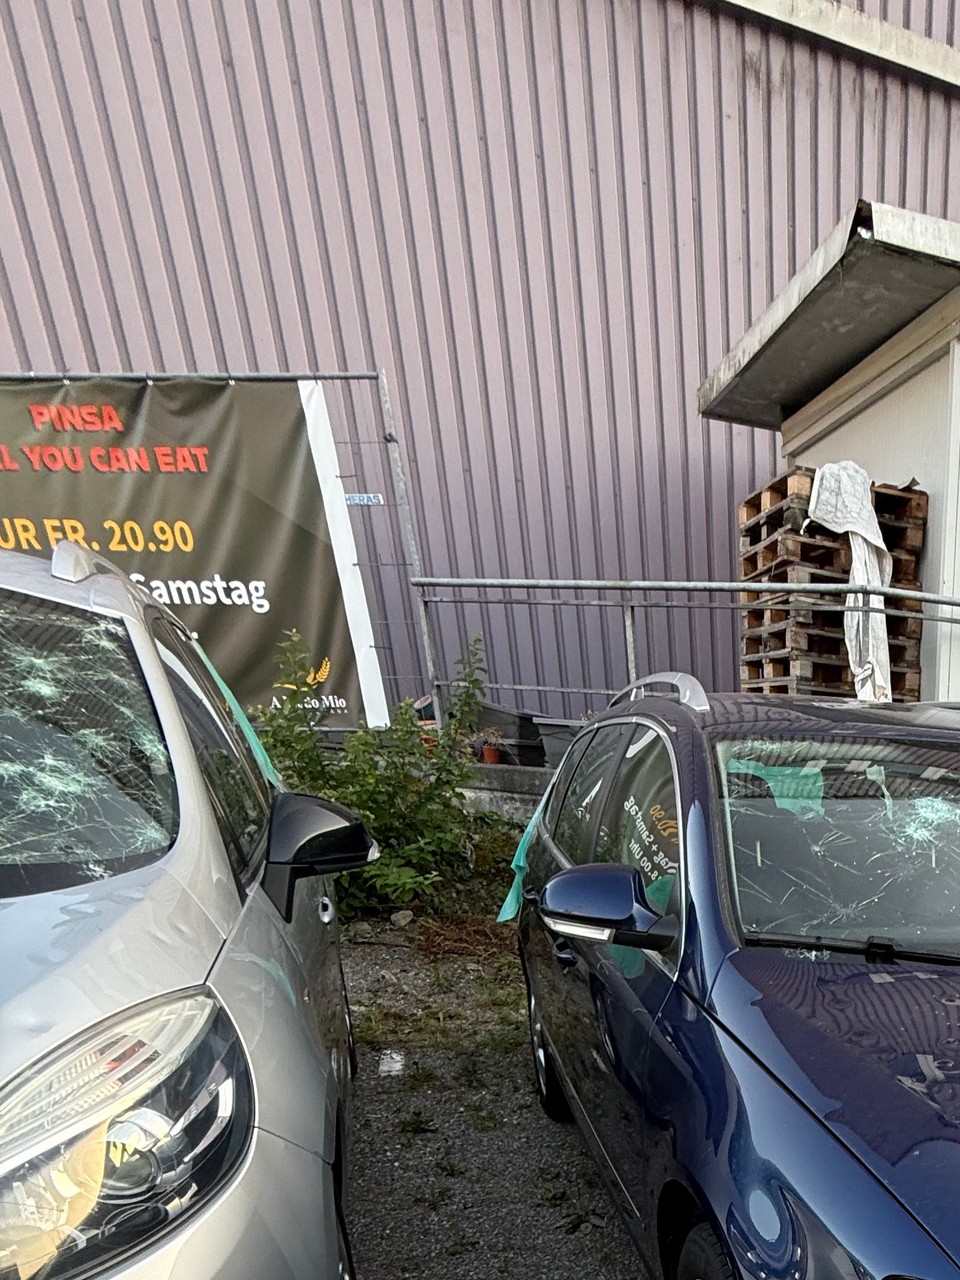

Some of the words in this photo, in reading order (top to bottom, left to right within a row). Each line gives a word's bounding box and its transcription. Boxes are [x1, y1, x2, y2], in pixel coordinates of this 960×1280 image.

[29, 404, 124, 432] PINSA
[22, 445, 84, 472] YOU
[90, 446, 151, 473] CAN
[154, 446, 208, 473] EAT
[0, 518, 42, 550] UR
[43, 519, 100, 550] FR.
[103, 520, 194, 552] 20.90
